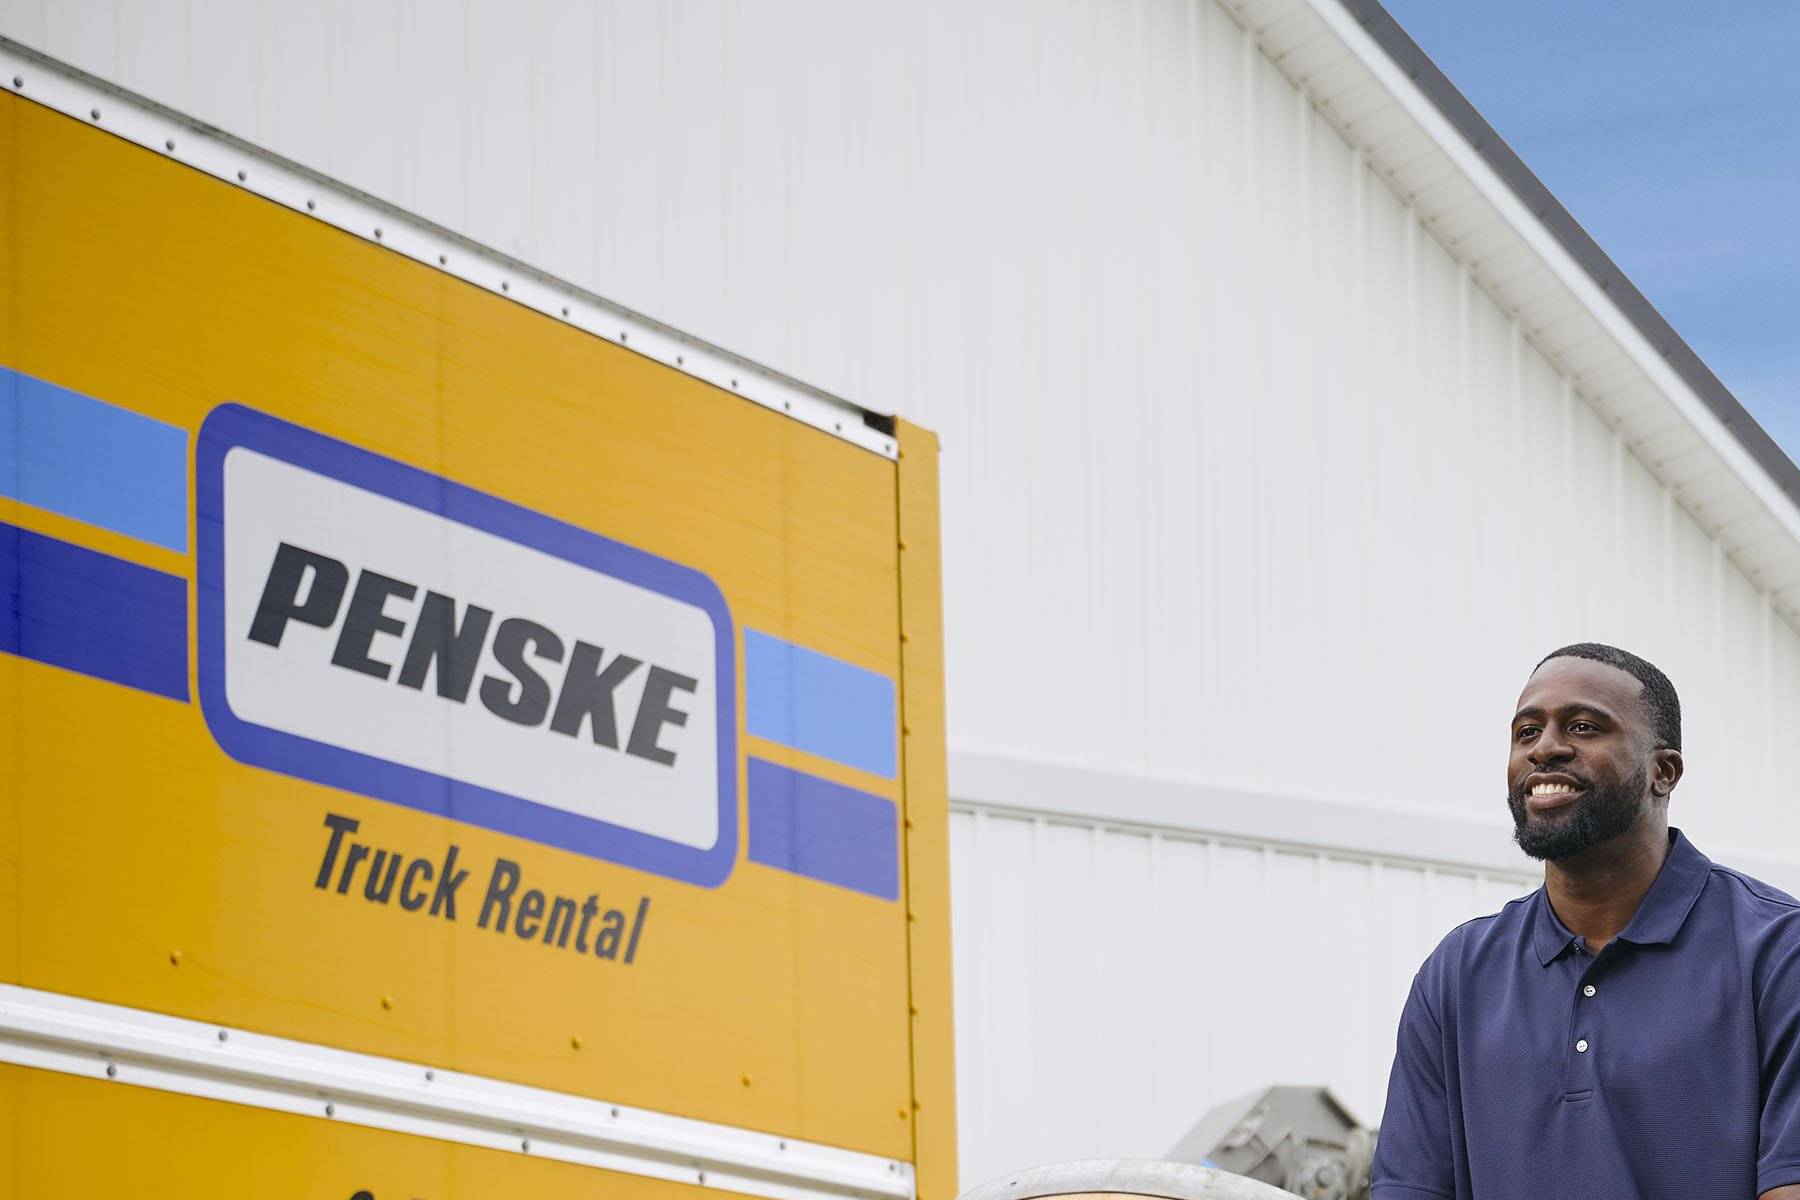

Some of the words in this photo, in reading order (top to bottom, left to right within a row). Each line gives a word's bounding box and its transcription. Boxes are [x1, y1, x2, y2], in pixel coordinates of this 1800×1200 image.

[248, 542, 698, 766] PENSKE
[314, 812, 469, 921] Truck
[477, 858, 650, 965] Rental
